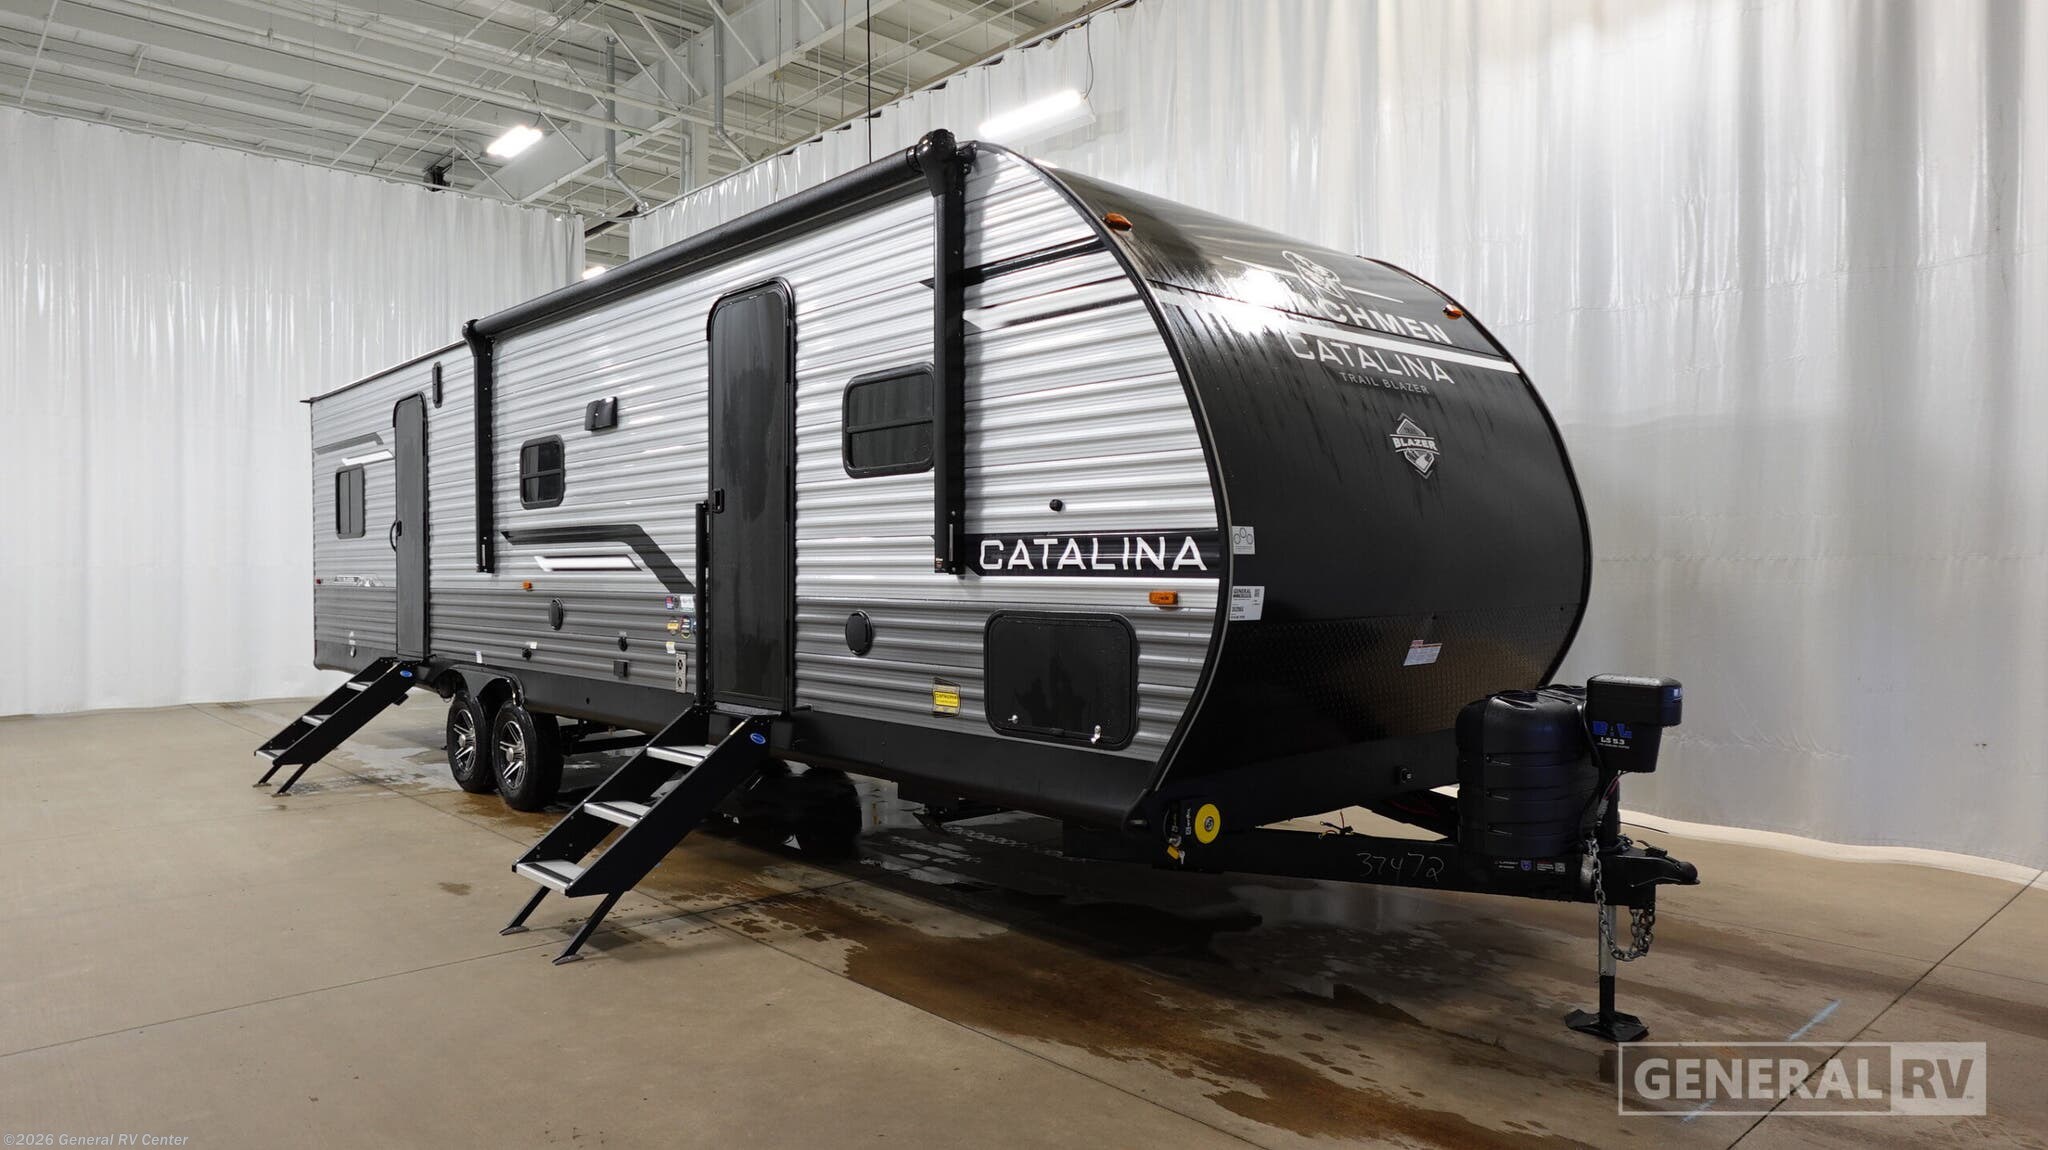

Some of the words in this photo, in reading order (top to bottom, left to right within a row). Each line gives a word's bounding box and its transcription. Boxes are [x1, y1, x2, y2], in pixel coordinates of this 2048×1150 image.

[1287, 333, 1455, 385] CATALINA
[1340, 372, 1380, 387] TRAIL
[1383, 379, 1430, 395] BLAZER
[1392, 437, 1438, 451] BLAZER
[979, 536, 1208, 571] CATALINA
[1356, 852, 1445, 882] 37472
